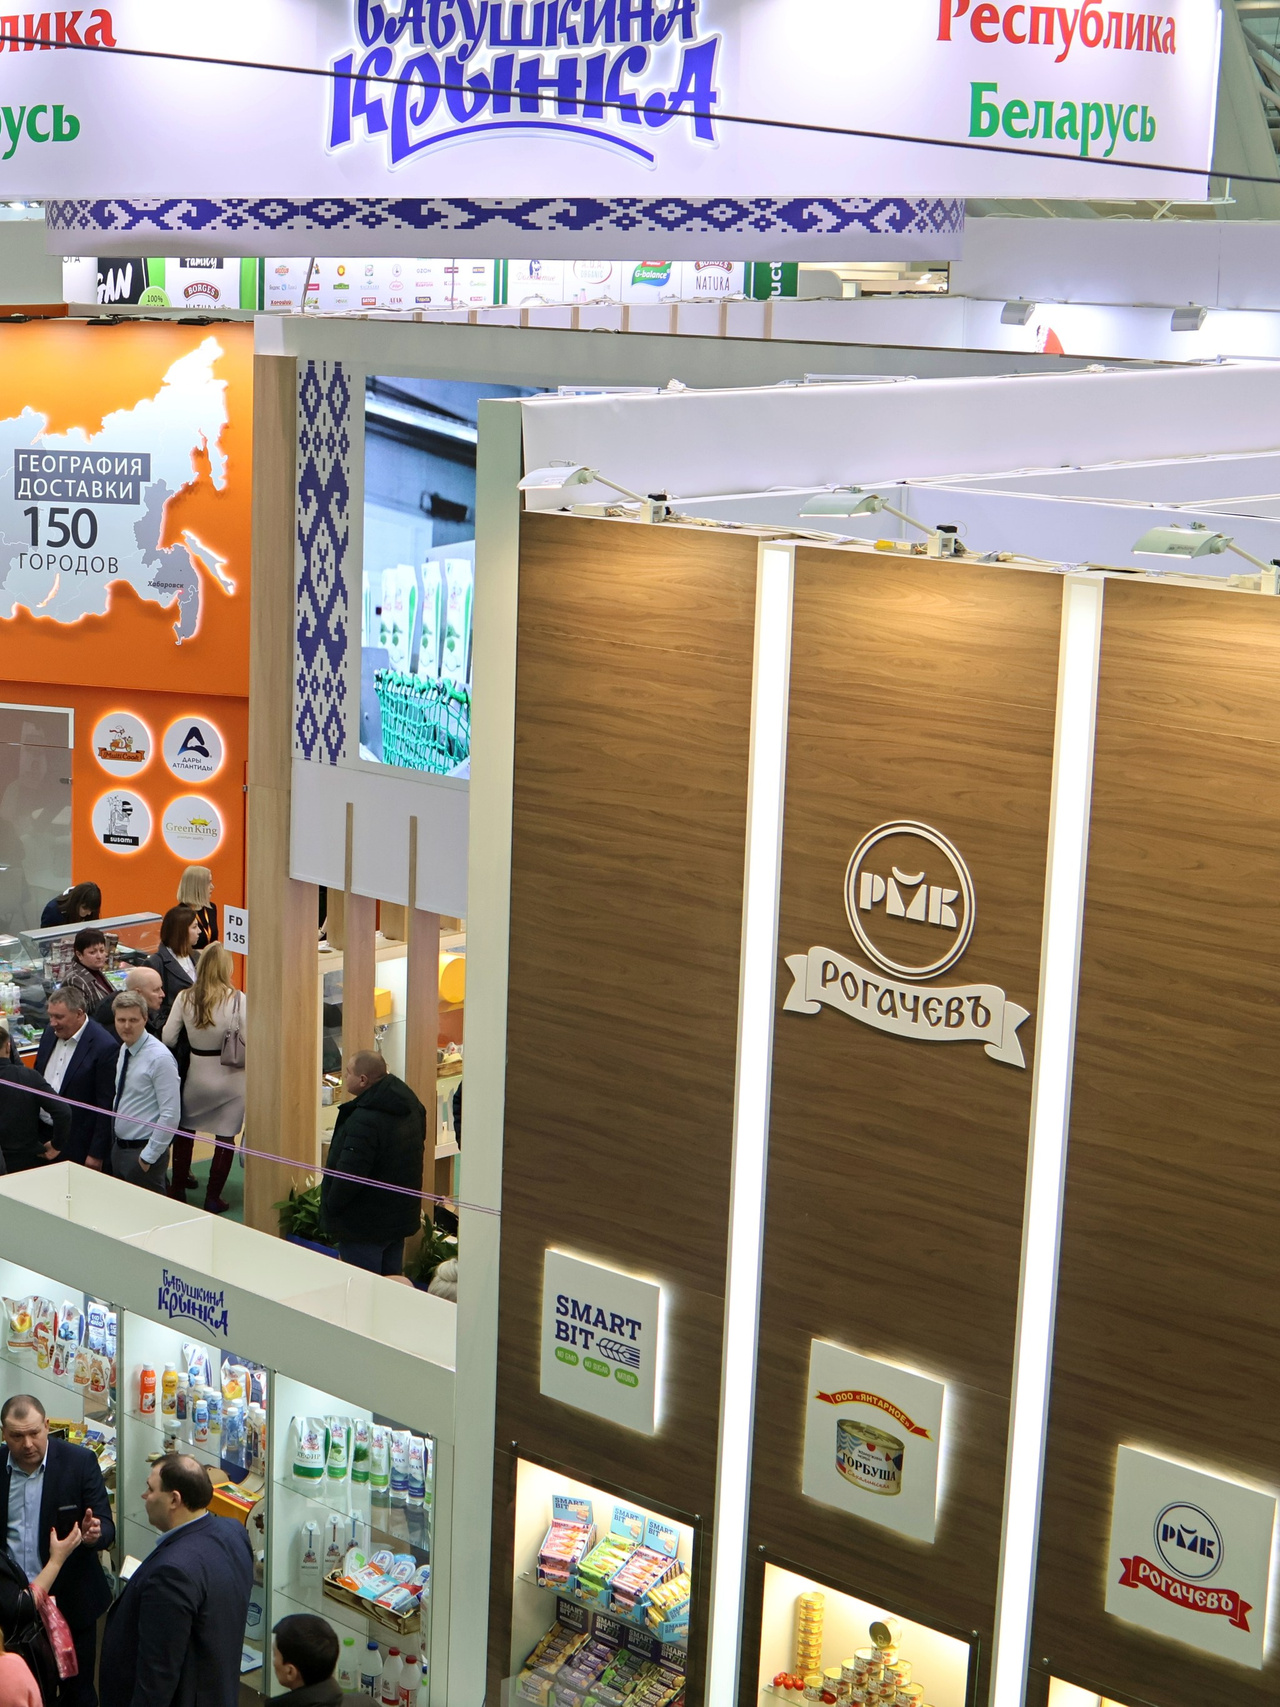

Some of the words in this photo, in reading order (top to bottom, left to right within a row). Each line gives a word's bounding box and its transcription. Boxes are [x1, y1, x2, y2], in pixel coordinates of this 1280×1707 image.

[936, 0, 1176, 63] Республика
[330, 38, 719, 164] КРЫНКА
[968, 82, 1156, 157] Беларусь
[635, 269, 667, 279] G-balance
[186, 281, 219, 296] BORGES
[695, 276, 730, 291] NATURA
[147, 294, 163, 303] 100%
[18, 454, 142, 476] ГЕОГРАФИЯ
[18, 478, 133, 499] ДОСТАВКИ
[23, 506, 98, 549] 150
[19, 552, 119, 576] ГОРОДОВ
[147, 581, 184, 589] Хабаровск
[172, 763, 213, 772] АТЛАНТИДЫ
[228, 914, 243, 927] FD
[226, 931, 246, 945] 135
[162, 1268, 224, 1308] БАБУШКИНА
[158, 1286, 228, 1337] КРЫНКА
[555, 1294, 642, 1341] SMART
[555, 1319, 595, 1350] BIT
[592, 1363, 608, 1375] SUGAR
[835, 1392, 854, 1402] ООО
[855, 1393, 910, 1427] «ЯНТАРНОЕ»
[842, 1452, 896, 1481] ГОРБУША
[554, 1497, 585, 1507] SMART
[614, 1507, 640, 1521] SMART
[648, 1521, 674, 1535] SMART
[596, 1615, 621, 1630] SMART
[628, 1629, 654, 1644] SMART
[662, 1643, 687, 1658] SMART
